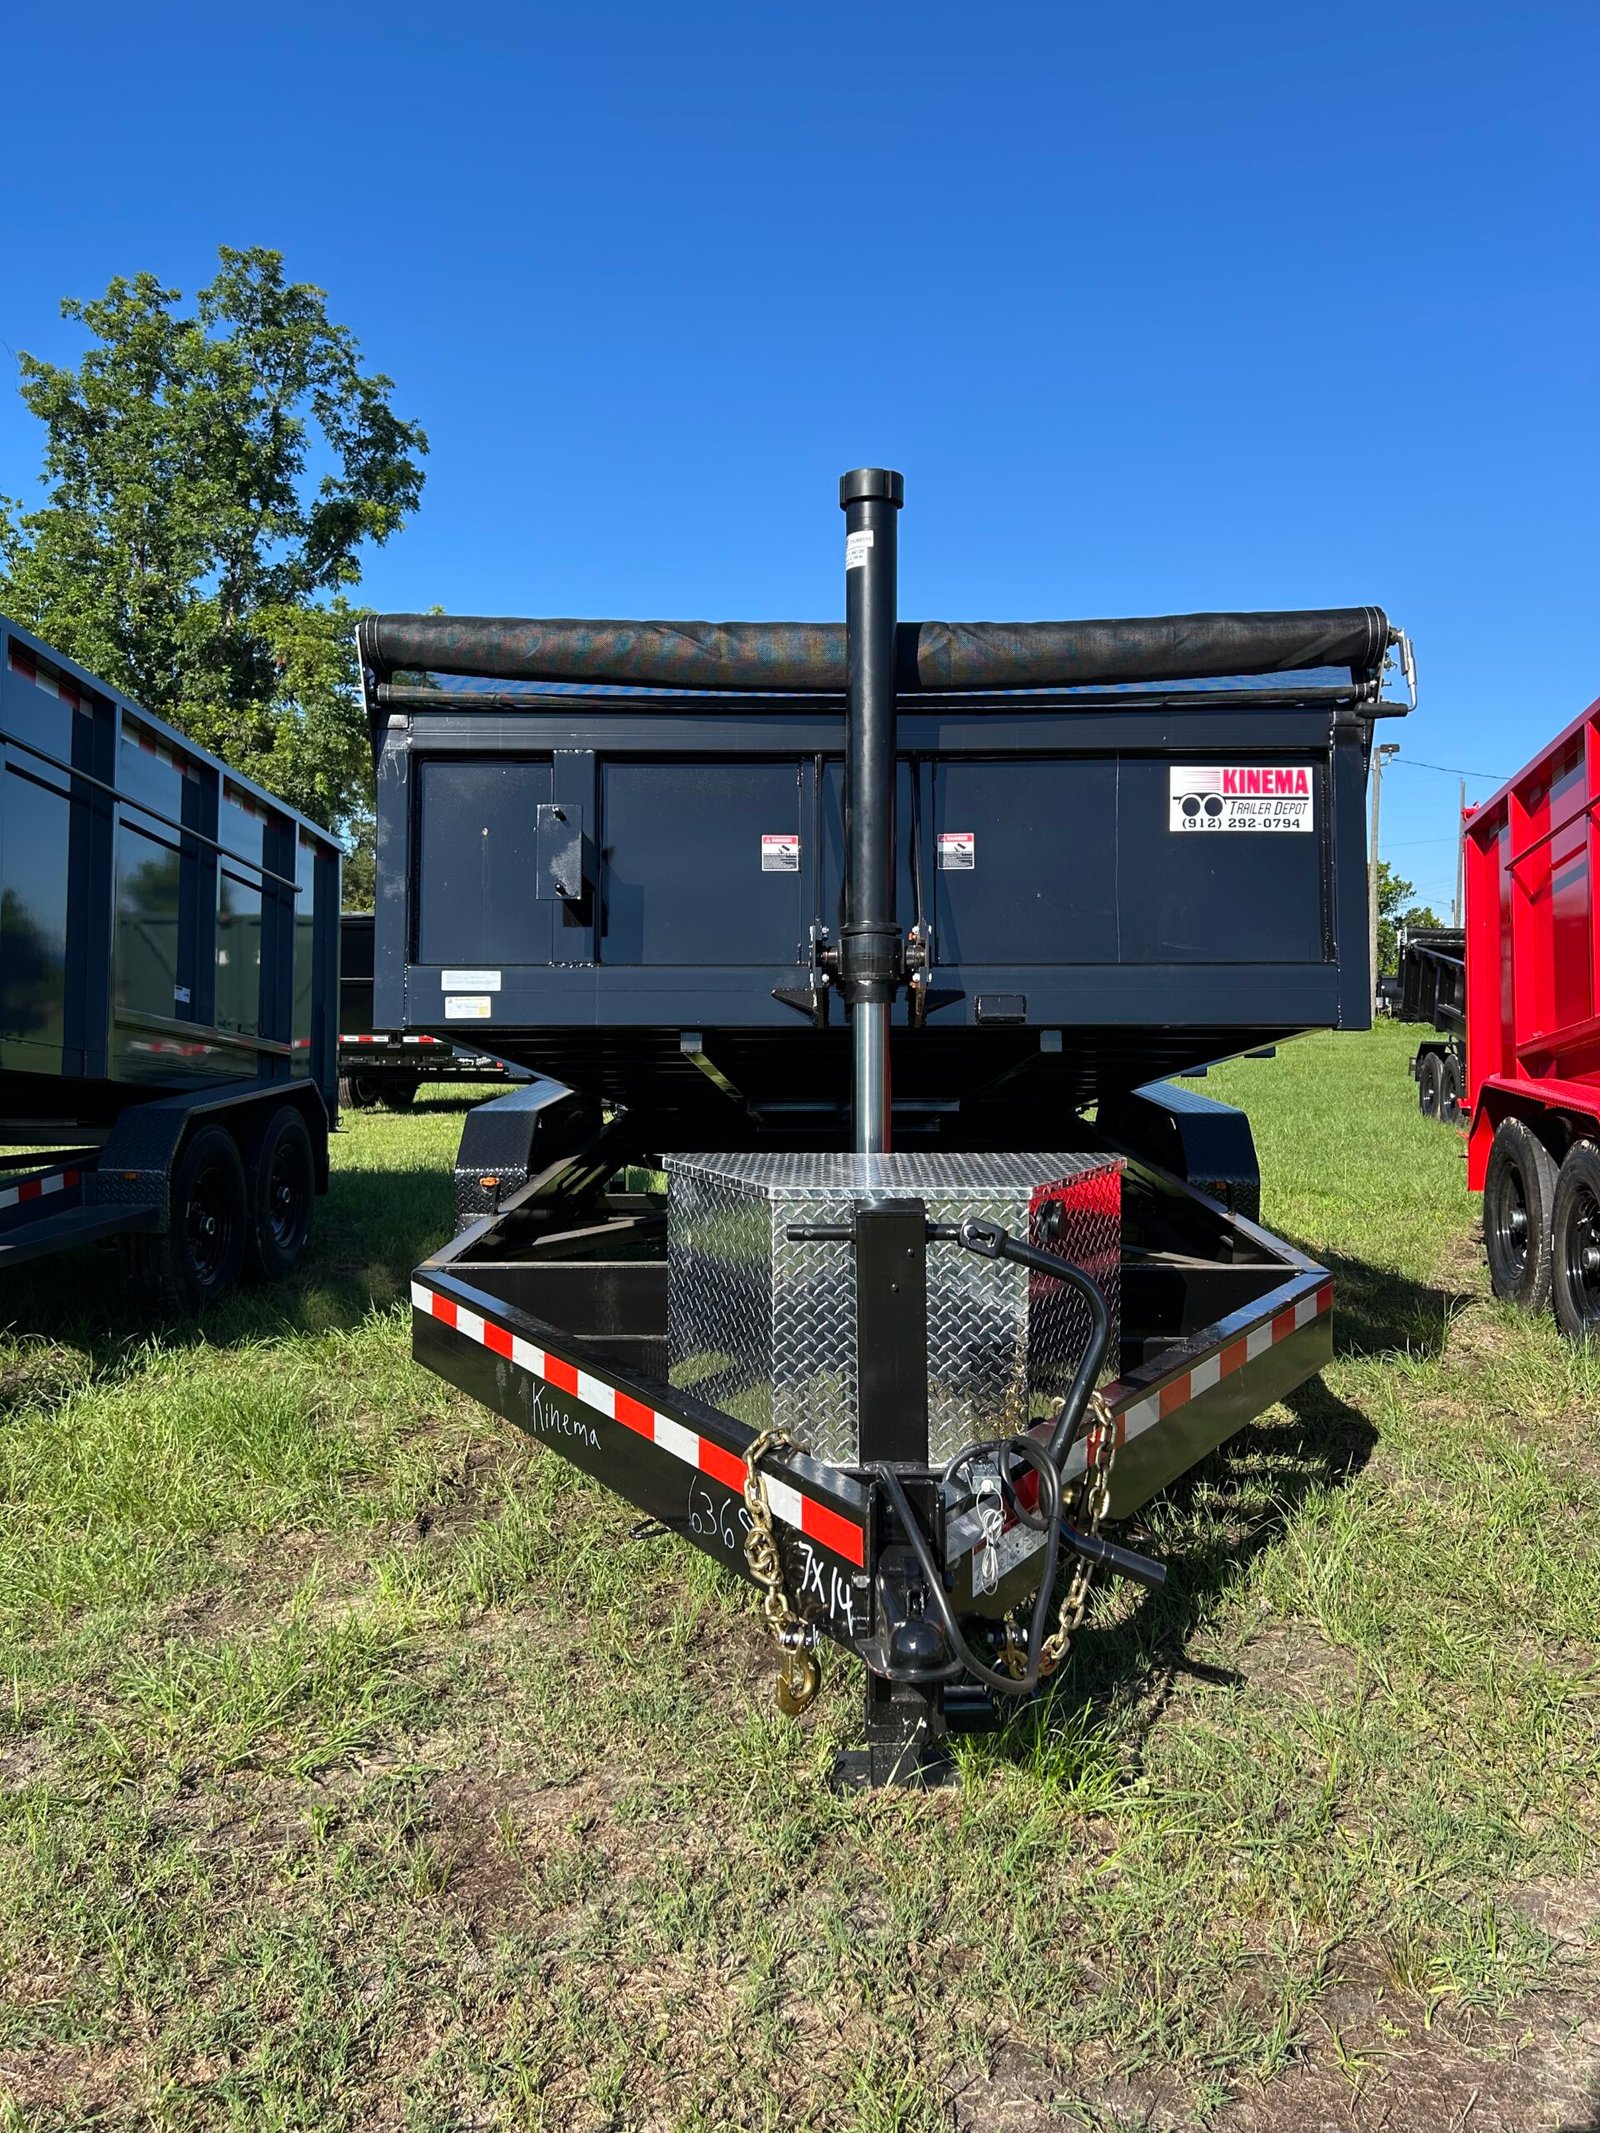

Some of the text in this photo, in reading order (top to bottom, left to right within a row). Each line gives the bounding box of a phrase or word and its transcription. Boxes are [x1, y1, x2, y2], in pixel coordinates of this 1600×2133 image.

[1223, 769, 1309, 794] KINEMA
[1230, 801, 1308, 815] TRAILER DEPOT
[1182, 818, 1300, 829] (912) 292-0794
[532, 1381, 602, 1450] Kinema
